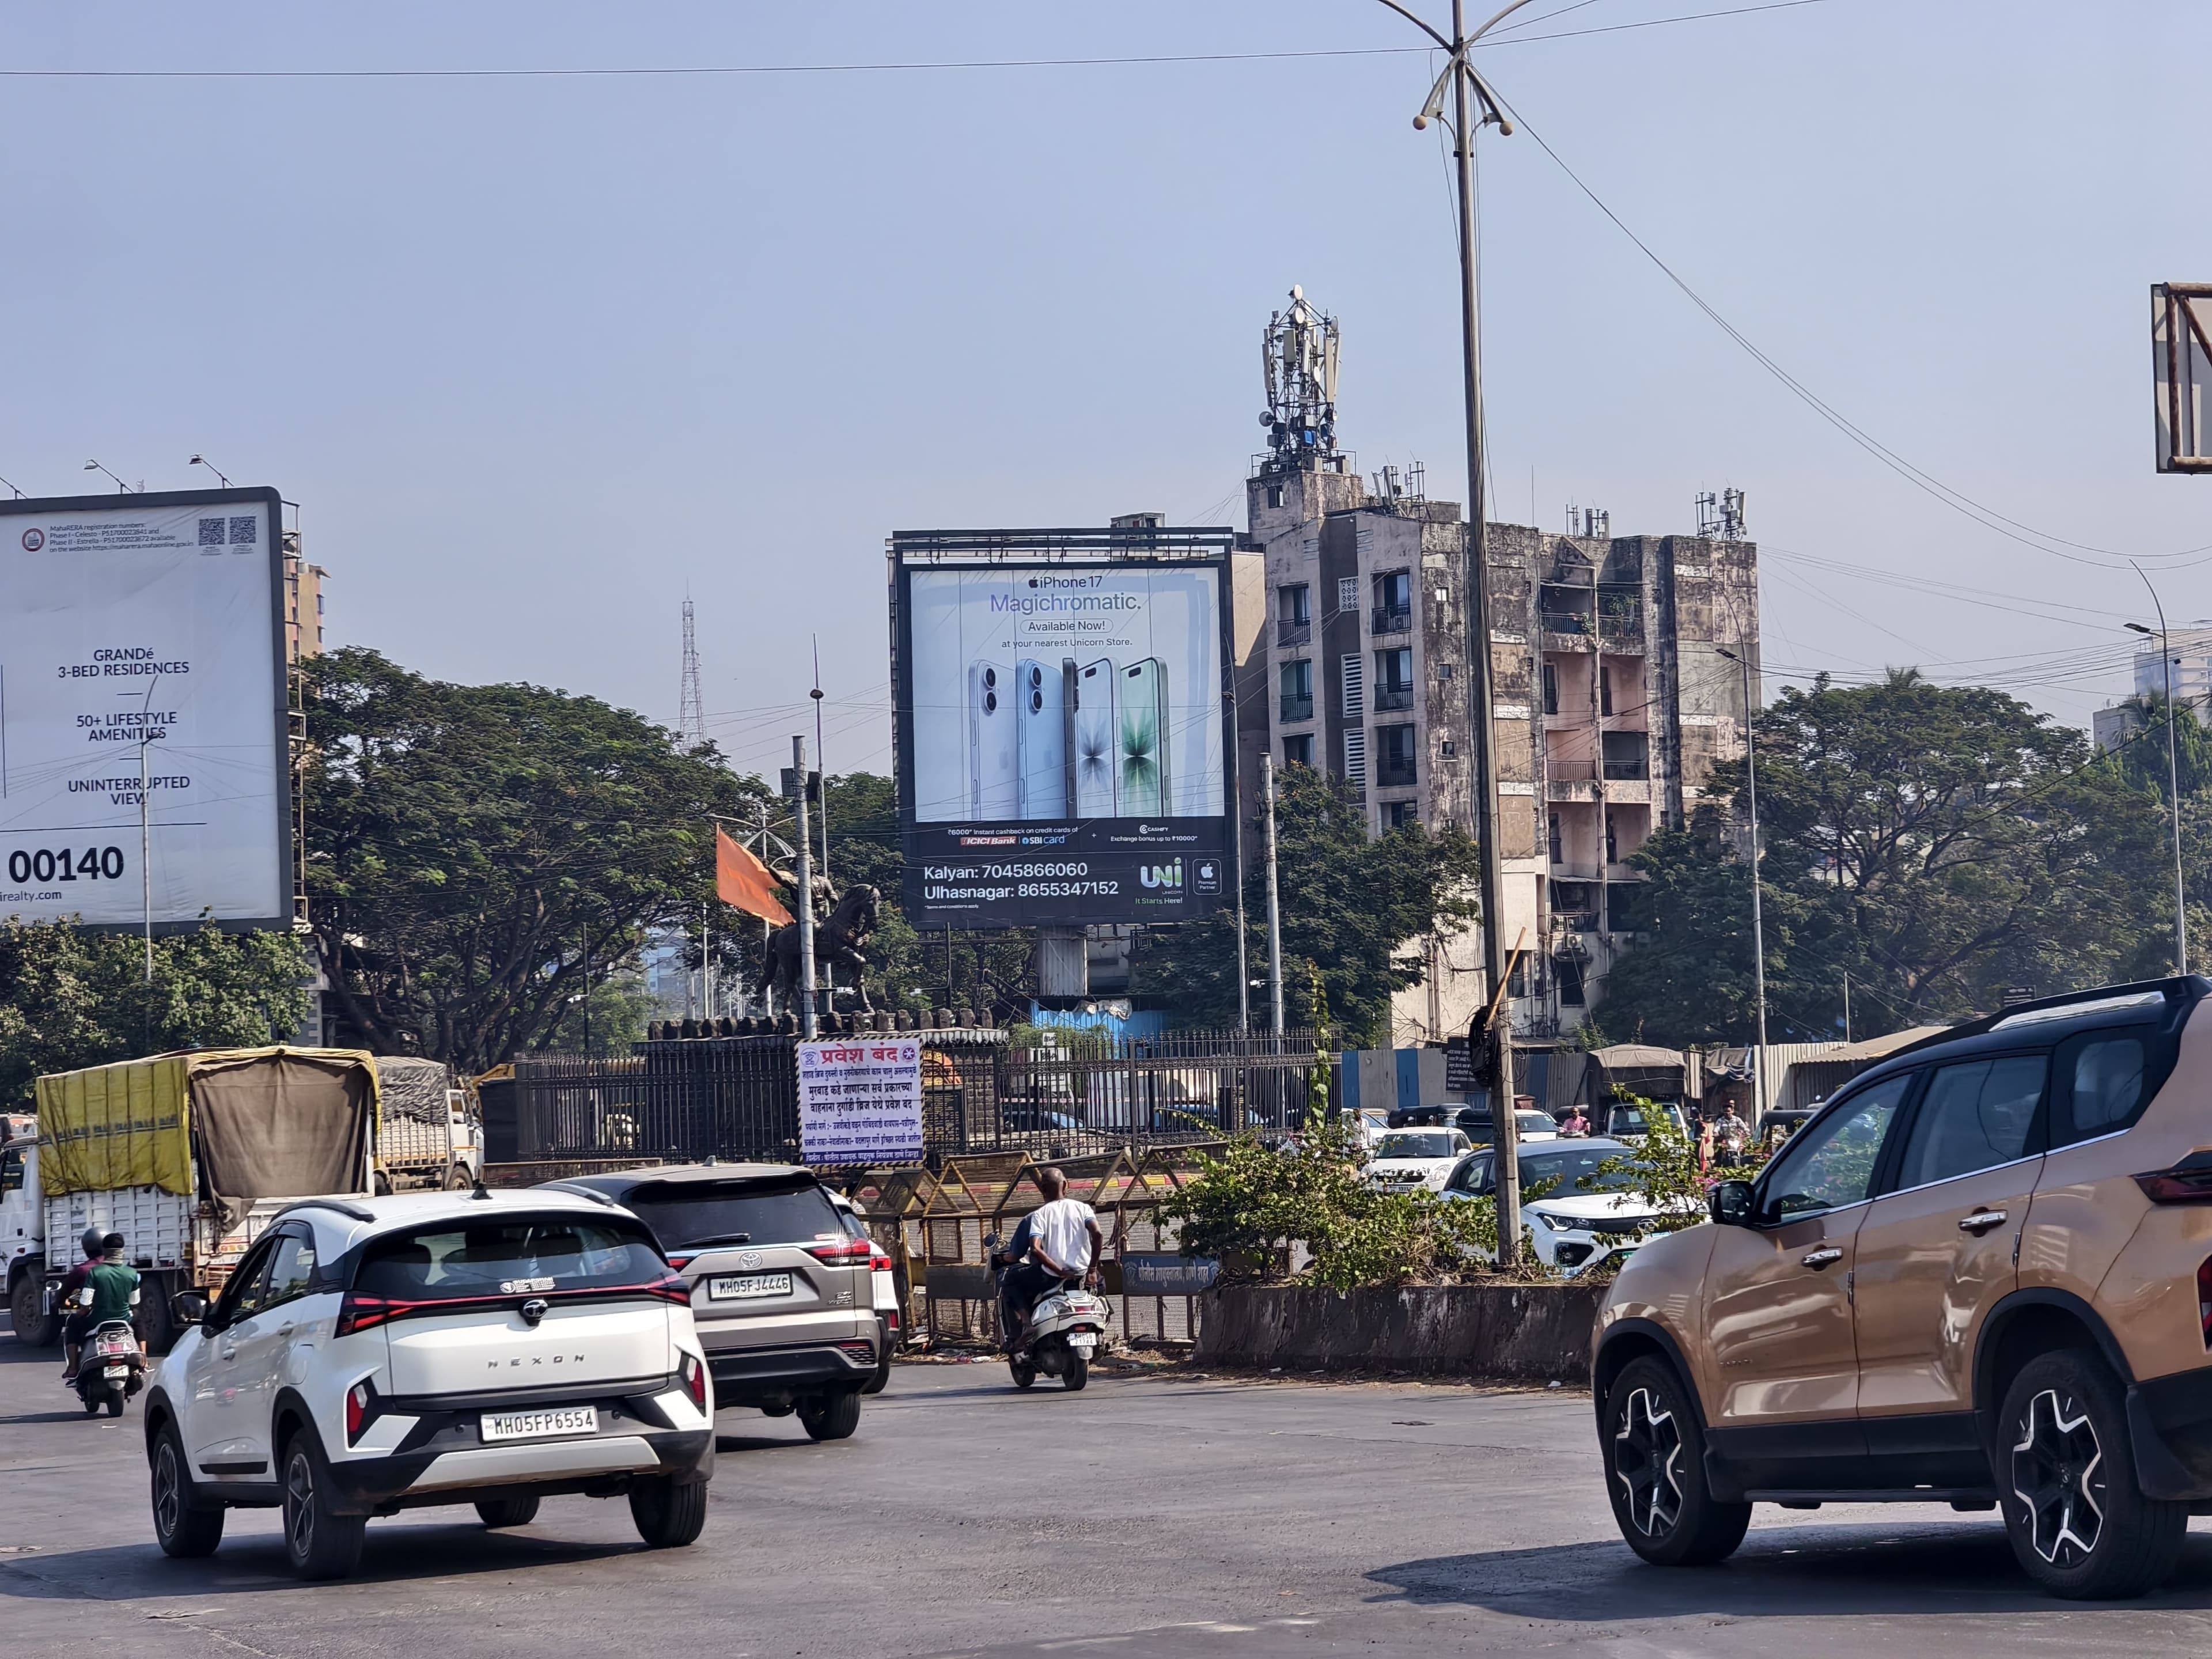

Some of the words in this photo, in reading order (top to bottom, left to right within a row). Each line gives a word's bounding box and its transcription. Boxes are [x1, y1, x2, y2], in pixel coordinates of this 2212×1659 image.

[148, 526, 159, 535] and
[1040, 576, 1086, 588] iPhone
[1089, 575, 1103, 588] 17
[990, 592, 1142, 616] Magichromatic.
[1028, 621, 1075, 631] Available
[1078, 620, 1105, 631] Now!
[1107, 638, 1132, 646] Store.
[93, 647, 154, 662] GRANDé
[58, 665, 100, 678] 3-BED
[104, 661, 190, 676] RESIDENCES
[76, 715, 102, 728] 50+
[106, 711, 177, 726] LIFESTYLE
[88, 727, 166, 741] AMENITIES
[68, 776, 190, 793] UNINTERRUPTED
[111, 792, 149, 805] VIEW
[991, 836, 1016, 844] Bank
[1043, 835, 1065, 844] card
[8, 846, 124, 883] 00140
[924, 866, 979, 882] Kalyan:
[982, 862, 1088, 878] 7045866060
[924, 885, 1014, 901] Ulhasnagar:
[1018, 881, 1119, 896] 8655347152
[820, 1043, 865, 1064] प्रवेश
[870, 1041, 898, 1063] बंद
[830, 1080, 842, 1095] कडे
[871, 1079, 882, 1093] सर्व
[884, 1082, 912, 1093] प्रकारच्या
[871, 1096, 882, 1110] येथे
[885, 1095, 900, 1111] प्रवेश
[902, 1095, 912, 1110] बंद
[719, 1277, 789, 1294] MH05FJ4446
[488, 1354, 585, 1369] NEXON
[494, 1411, 593, 1434] MH05FP6554
